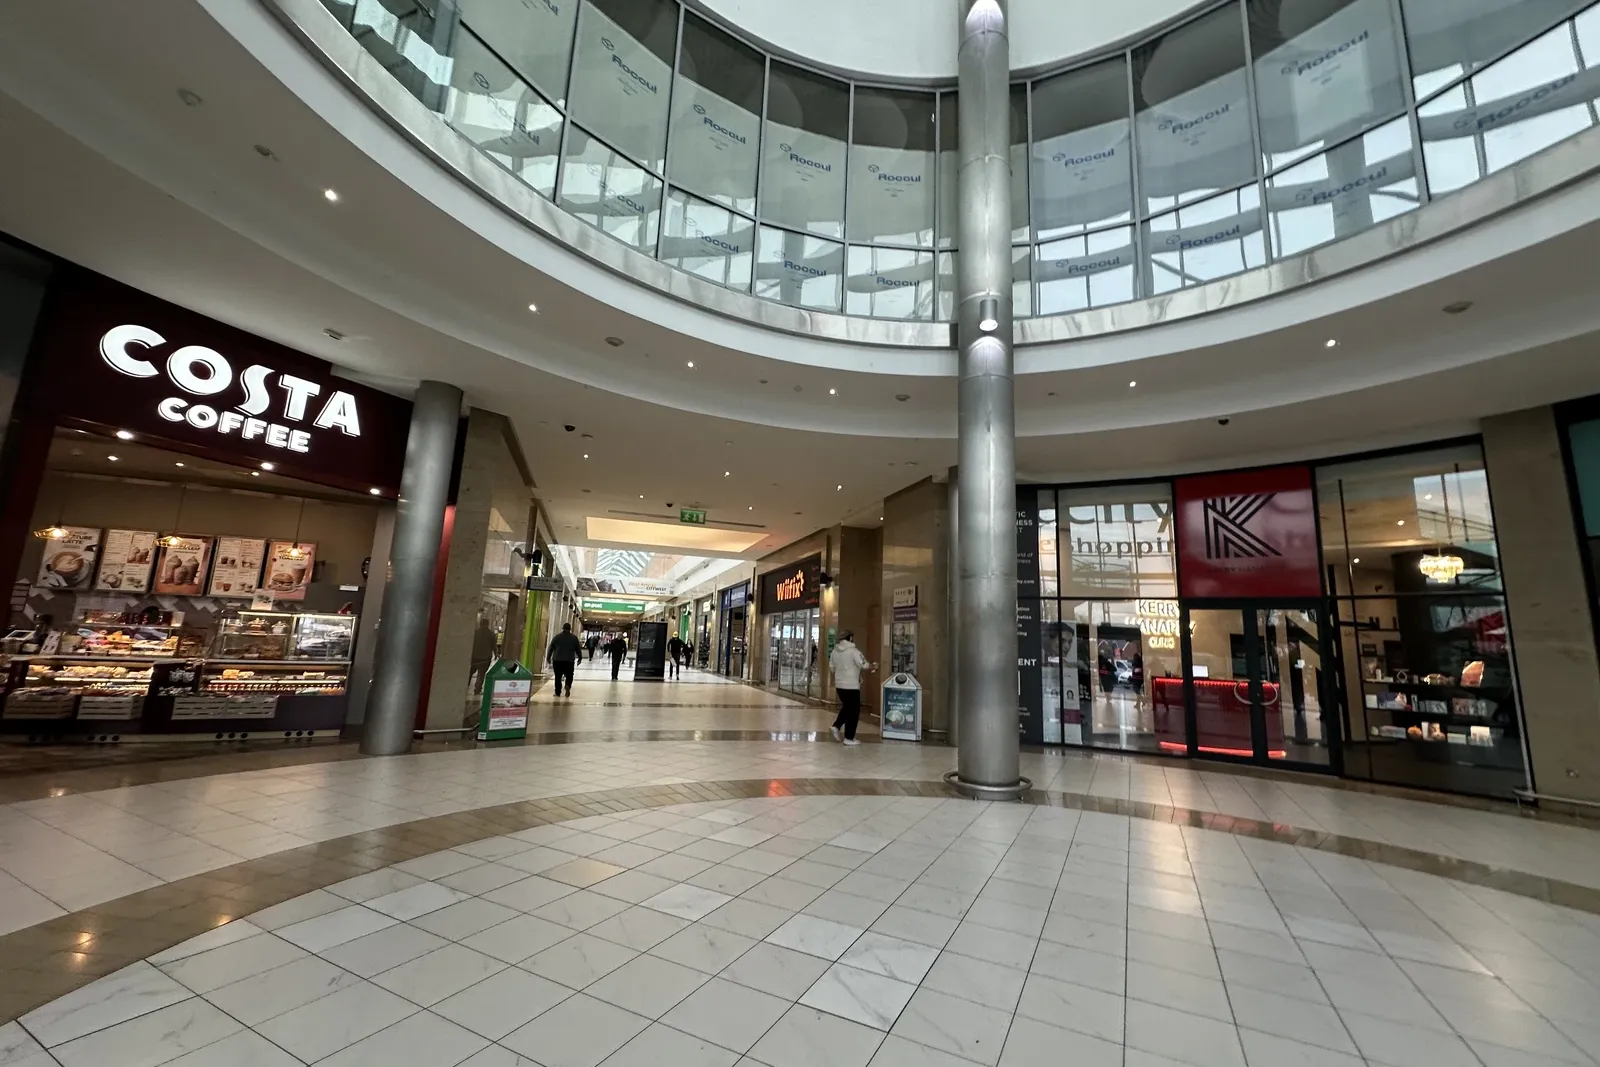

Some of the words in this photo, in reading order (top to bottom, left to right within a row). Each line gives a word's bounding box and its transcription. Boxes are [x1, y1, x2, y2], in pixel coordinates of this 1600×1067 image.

[612, 53, 657, 94] Roccul
[703, 117, 746, 144] Roccul
[99, 324, 361, 437] COSTA
[157, 397, 311, 453] COFFEE
[1071, 537, 1174, 558] hoppi
